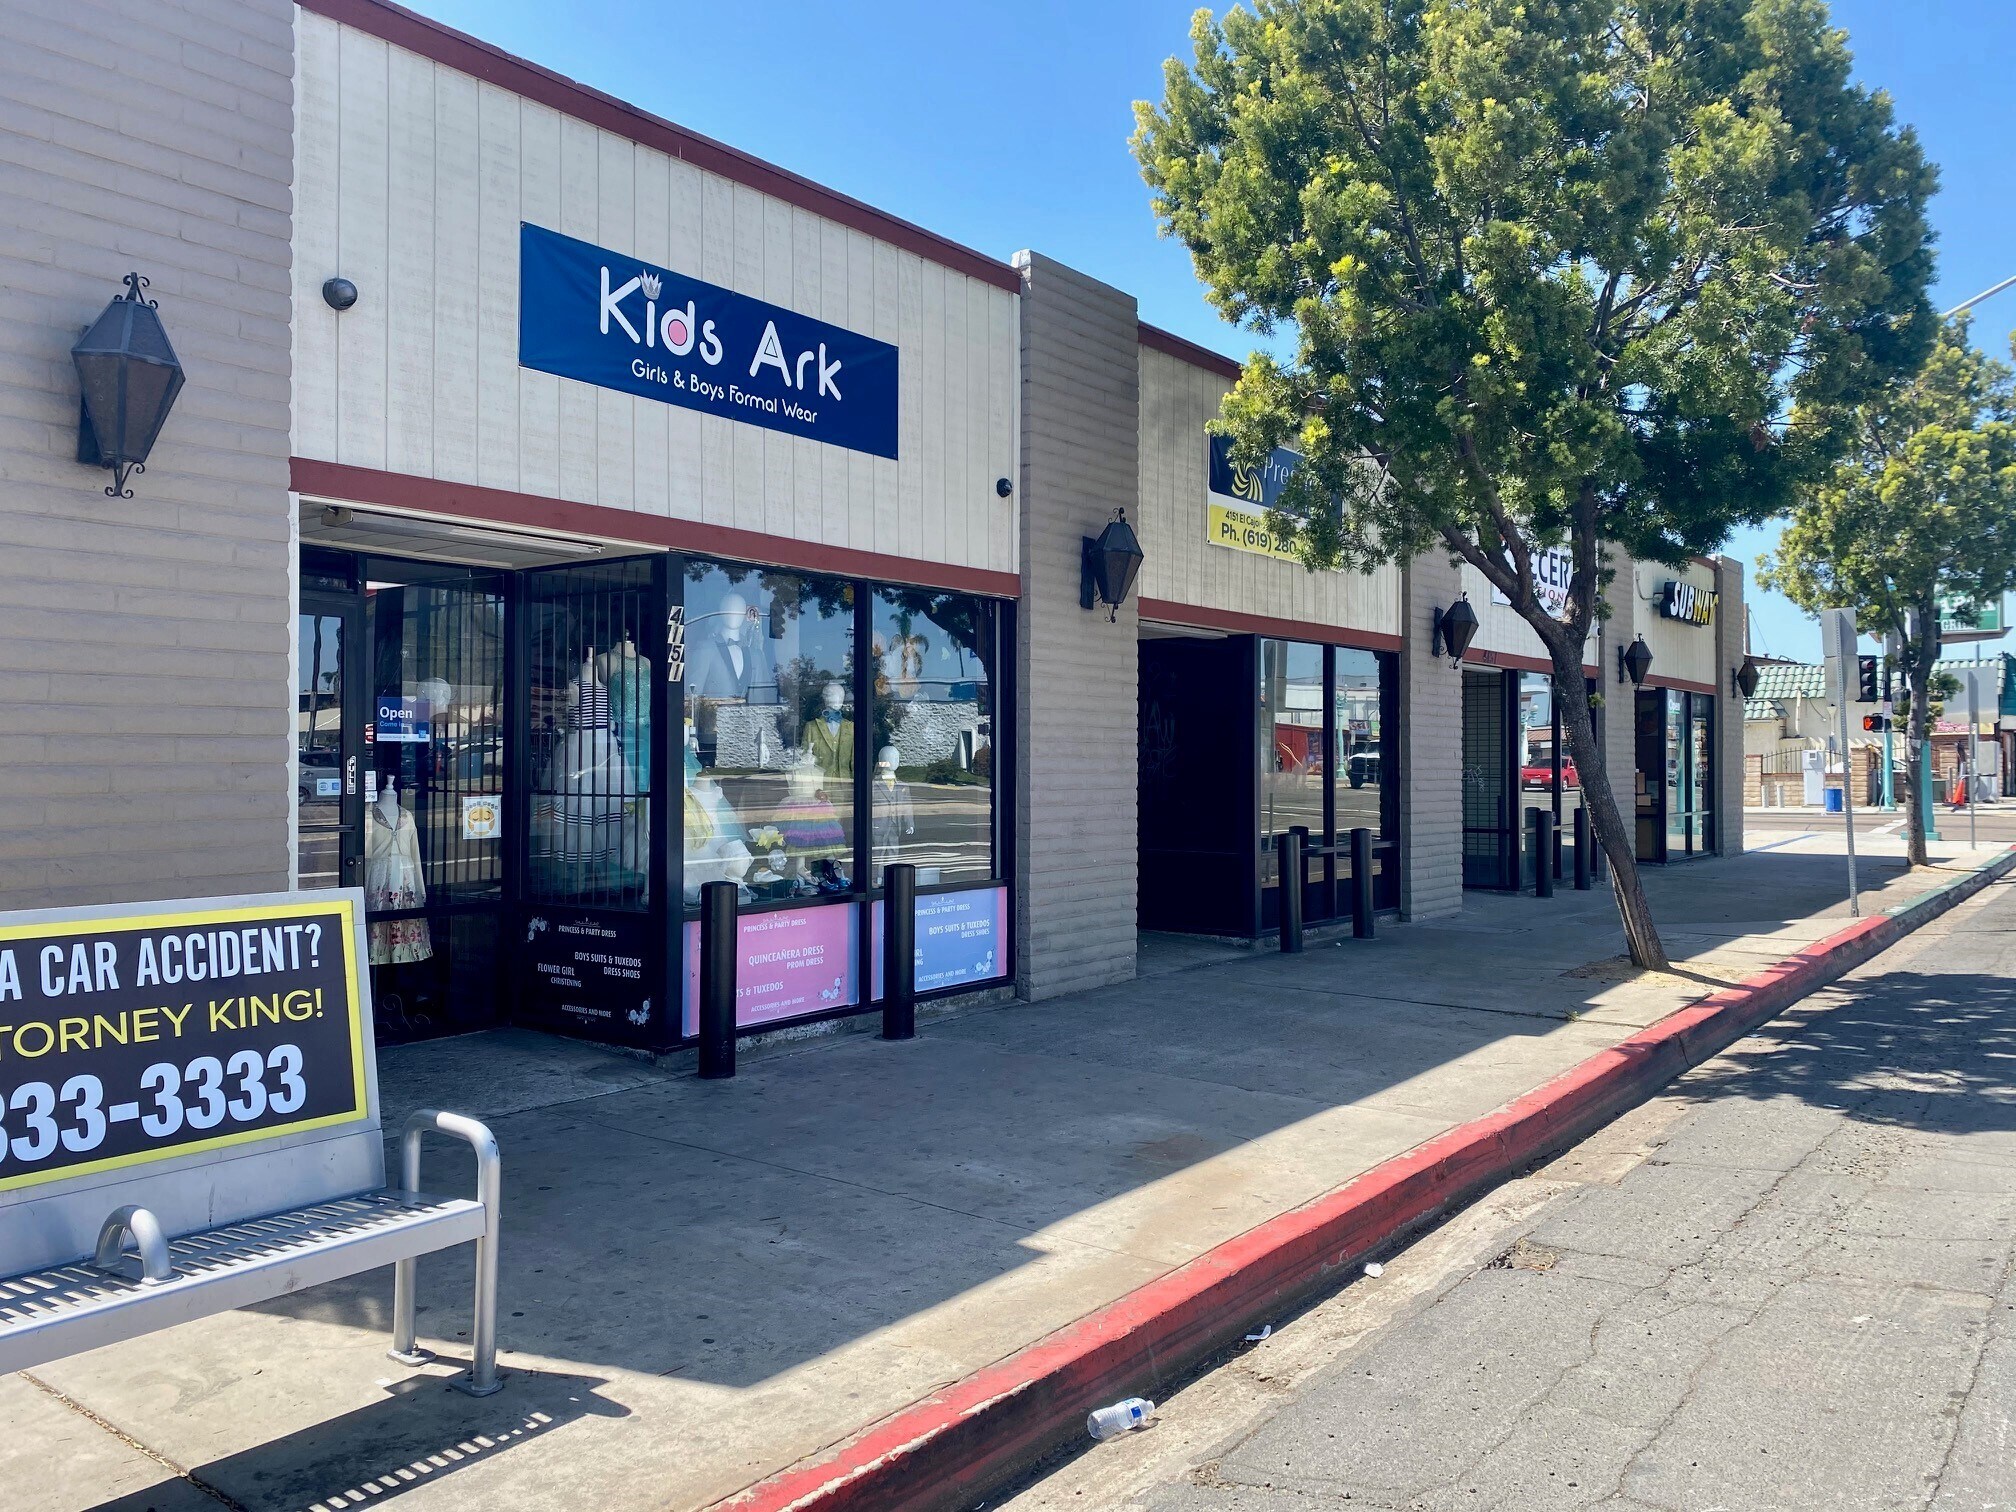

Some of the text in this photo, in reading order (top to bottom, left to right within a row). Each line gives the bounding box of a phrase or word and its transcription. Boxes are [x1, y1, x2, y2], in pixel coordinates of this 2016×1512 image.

[600, 265, 842, 401] Kids Ark
[631, 359, 818, 424] Girls & Boys Formal Wear
[1246, 515, 1260, 528] Cajo
[1221, 522, 1240, 541] Ph.
[1243, 528, 1272, 553] (619)
[1670, 581, 1719, 626] SUBWAY
[380, 706, 413, 721] Open
[941, 905, 956, 913] PARTY
[558, 925, 580, 934] PRINCESS
[585, 928, 600, 936] PARTY
[601, 929, 617, 938] DRESS
[743, 923, 768, 933] PRINCESS
[774, 920, 790, 929] PARTY
[791, 918, 807, 927] DRESS
[928, 925, 944, 936] BOYS
[945, 923, 960, 933] SUITS
[967, 919, 990, 930] TUXEDOS
[0, 923, 322, 1000] A CAR ACCIDENT?
[574, 952, 642, 968] BOYS SUITS & TUXEDOS
[748, 945, 824, 967] QUINCEAÑERA DRESS
[786, 956, 824, 970] PROM DRESS
[537, 963, 575, 976] FLOWER GIRL
[603, 966, 641, 979] DRESS SHOES
[745, 987, 751, 996] &
[753, 981, 784, 995] TUXEDOS
[209, 988, 324, 1032] KING!
[0, 1044, 306, 1163] 33-3333
